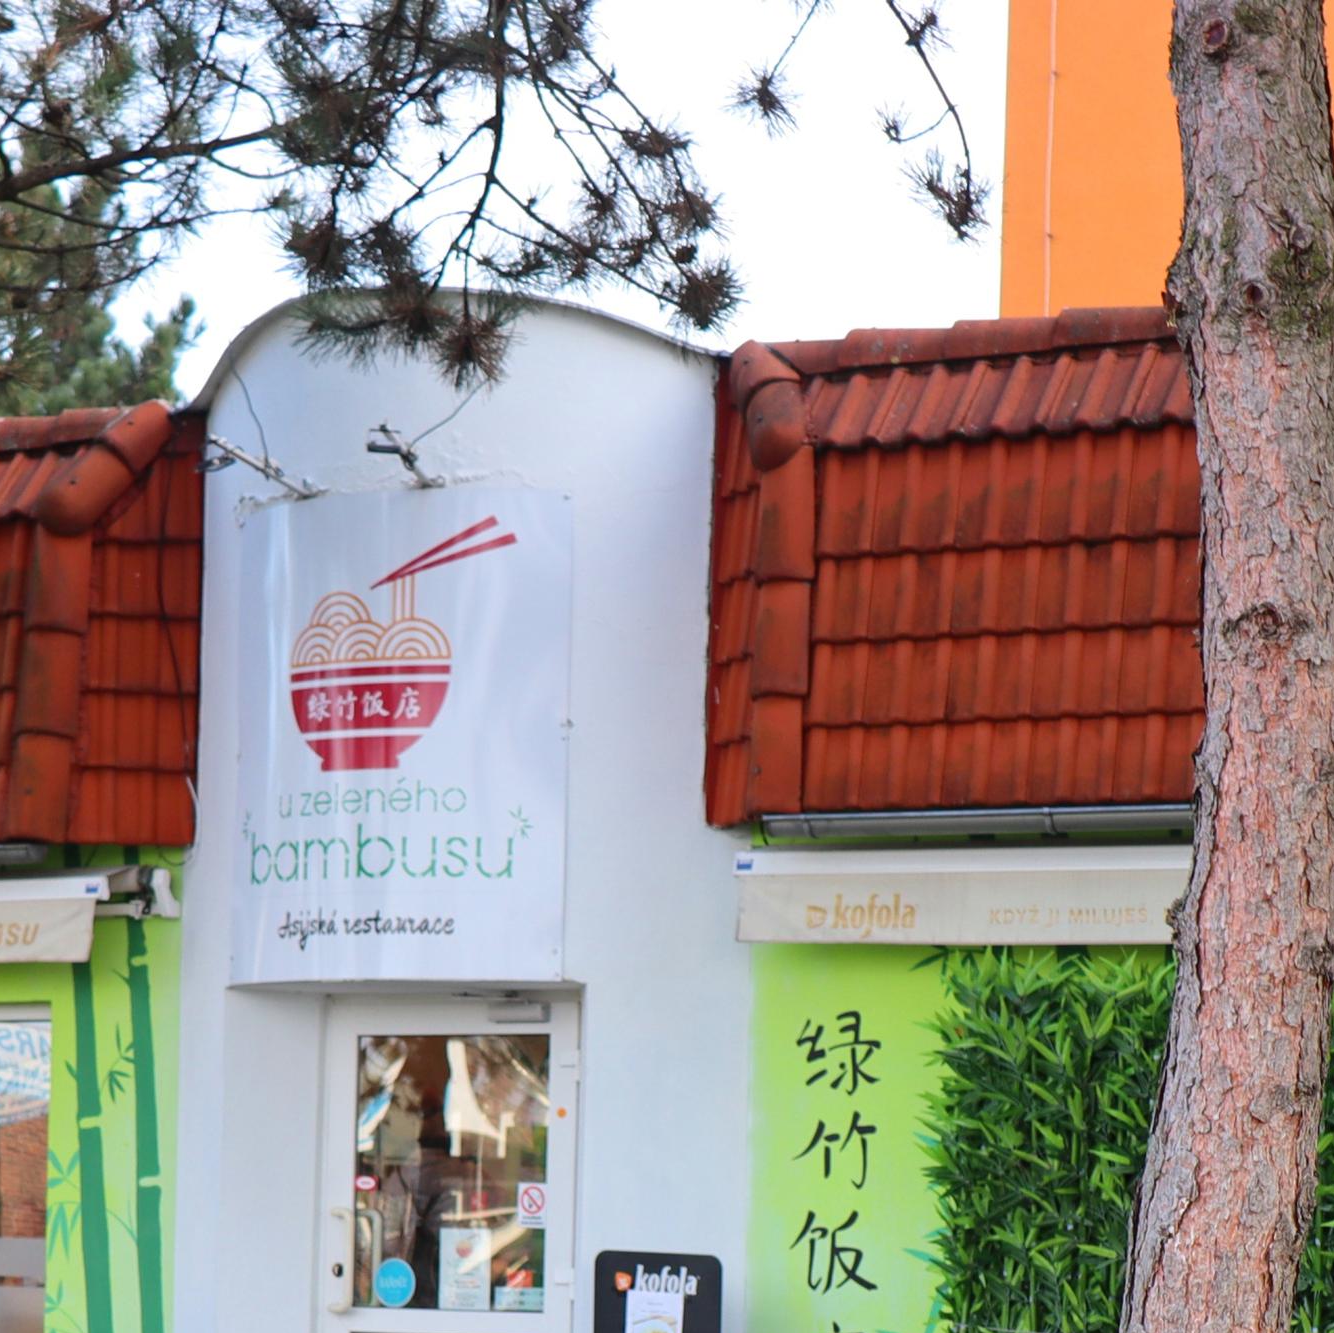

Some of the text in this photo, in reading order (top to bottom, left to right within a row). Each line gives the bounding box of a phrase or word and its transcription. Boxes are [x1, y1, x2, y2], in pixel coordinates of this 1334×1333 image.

[279, 778, 467, 819] u zeleného
[250, 823, 514, 885] bambusu
[344, 911, 455, 938] restaurace
[831, 892, 916, 938] kofola
[634, 1263, 698, 1296] kofola
